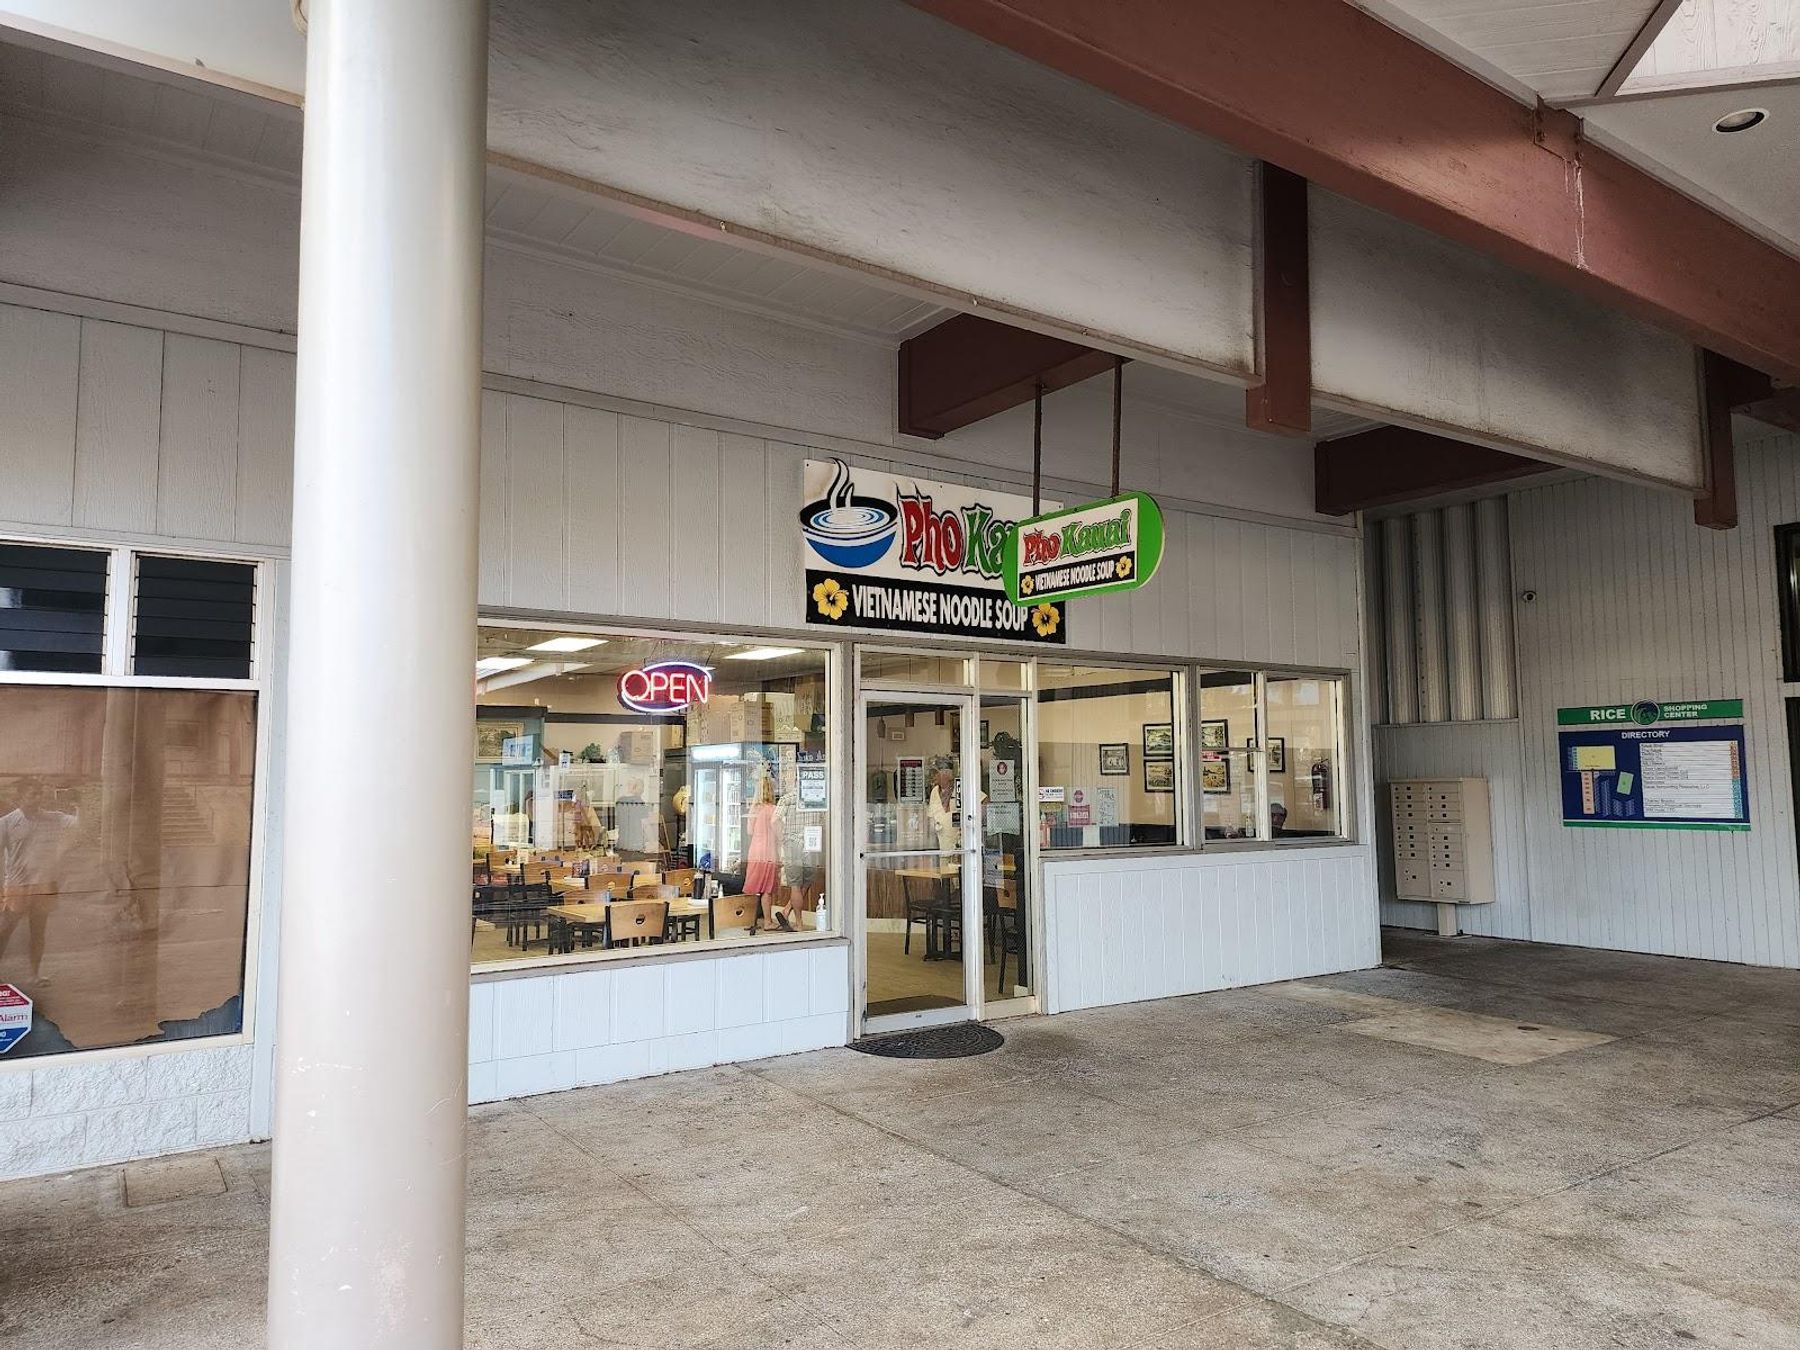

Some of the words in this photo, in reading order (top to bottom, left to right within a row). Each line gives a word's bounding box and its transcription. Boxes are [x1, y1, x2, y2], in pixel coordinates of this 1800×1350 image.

[896, 490, 962, 576] Pho
[1023, 528, 1061, 566] Pho
[1035, 569, 1070, 592] VIETNAMESE
[1070, 563, 1097, 584] NOODLE
[1097, 560, 1115, 580] SOUP
[851, 584, 937, 624] VIETNAMESE
[939, 593, 993, 629] NOODLE
[995, 599, 1028, 631] SOUP
[621, 670, 709, 704] OPEN
[1590, 708, 1626, 720] RICE
[1663, 704, 1708, 712] SHOPPING
[1664, 711, 1699, 719] CENTER
[1621, 730, 1671, 740] DIRECTORY
[803, 770, 825, 780] PASS
